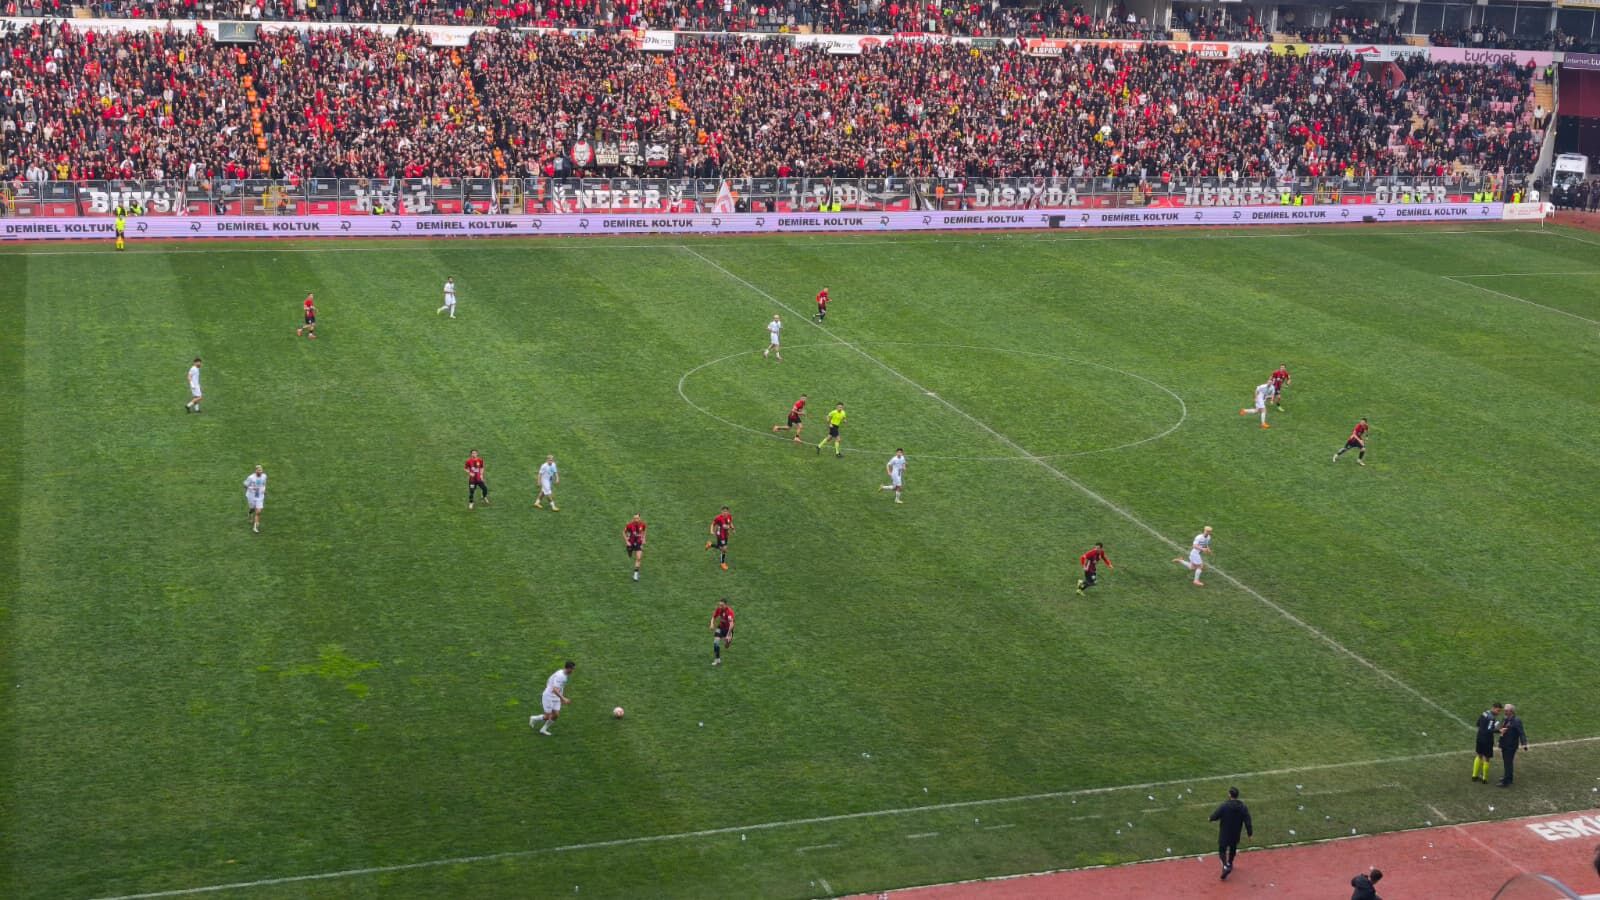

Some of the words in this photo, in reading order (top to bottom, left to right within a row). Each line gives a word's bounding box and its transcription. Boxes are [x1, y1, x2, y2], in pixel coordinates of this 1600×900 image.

[575, 189, 661, 209] NEFER
[1184, 186, 1292, 206] HERKES
[1101, 212, 1141, 222] DEMİREL
[1143, 212, 1180, 222] KOLTUK
[1252, 210, 1290, 220] DEMİREL
[1291, 210, 1326, 219] KOLTUK
[1396, 207, 1432, 217] DEMİREL
[1434, 207, 1468, 216] KOLTUK
[603, 218, 648, 228] DEMİREL
[651, 218, 693, 228] KOLTUK
[778, 217, 821, 227] DEMİREL
[823, 217, 863, 226] KOLTUK
[943, 214, 984, 225] DEMİREL
[987, 214, 1025, 224] KOLTUK
[6, 222, 61, 233] DEMİREL
[64, 222, 115, 233] KOLTUK
[217, 221, 269, 232] DEMİREL
[272, 221, 320, 231] KOLTUK
[416, 220, 464, 230] DEMİREL
